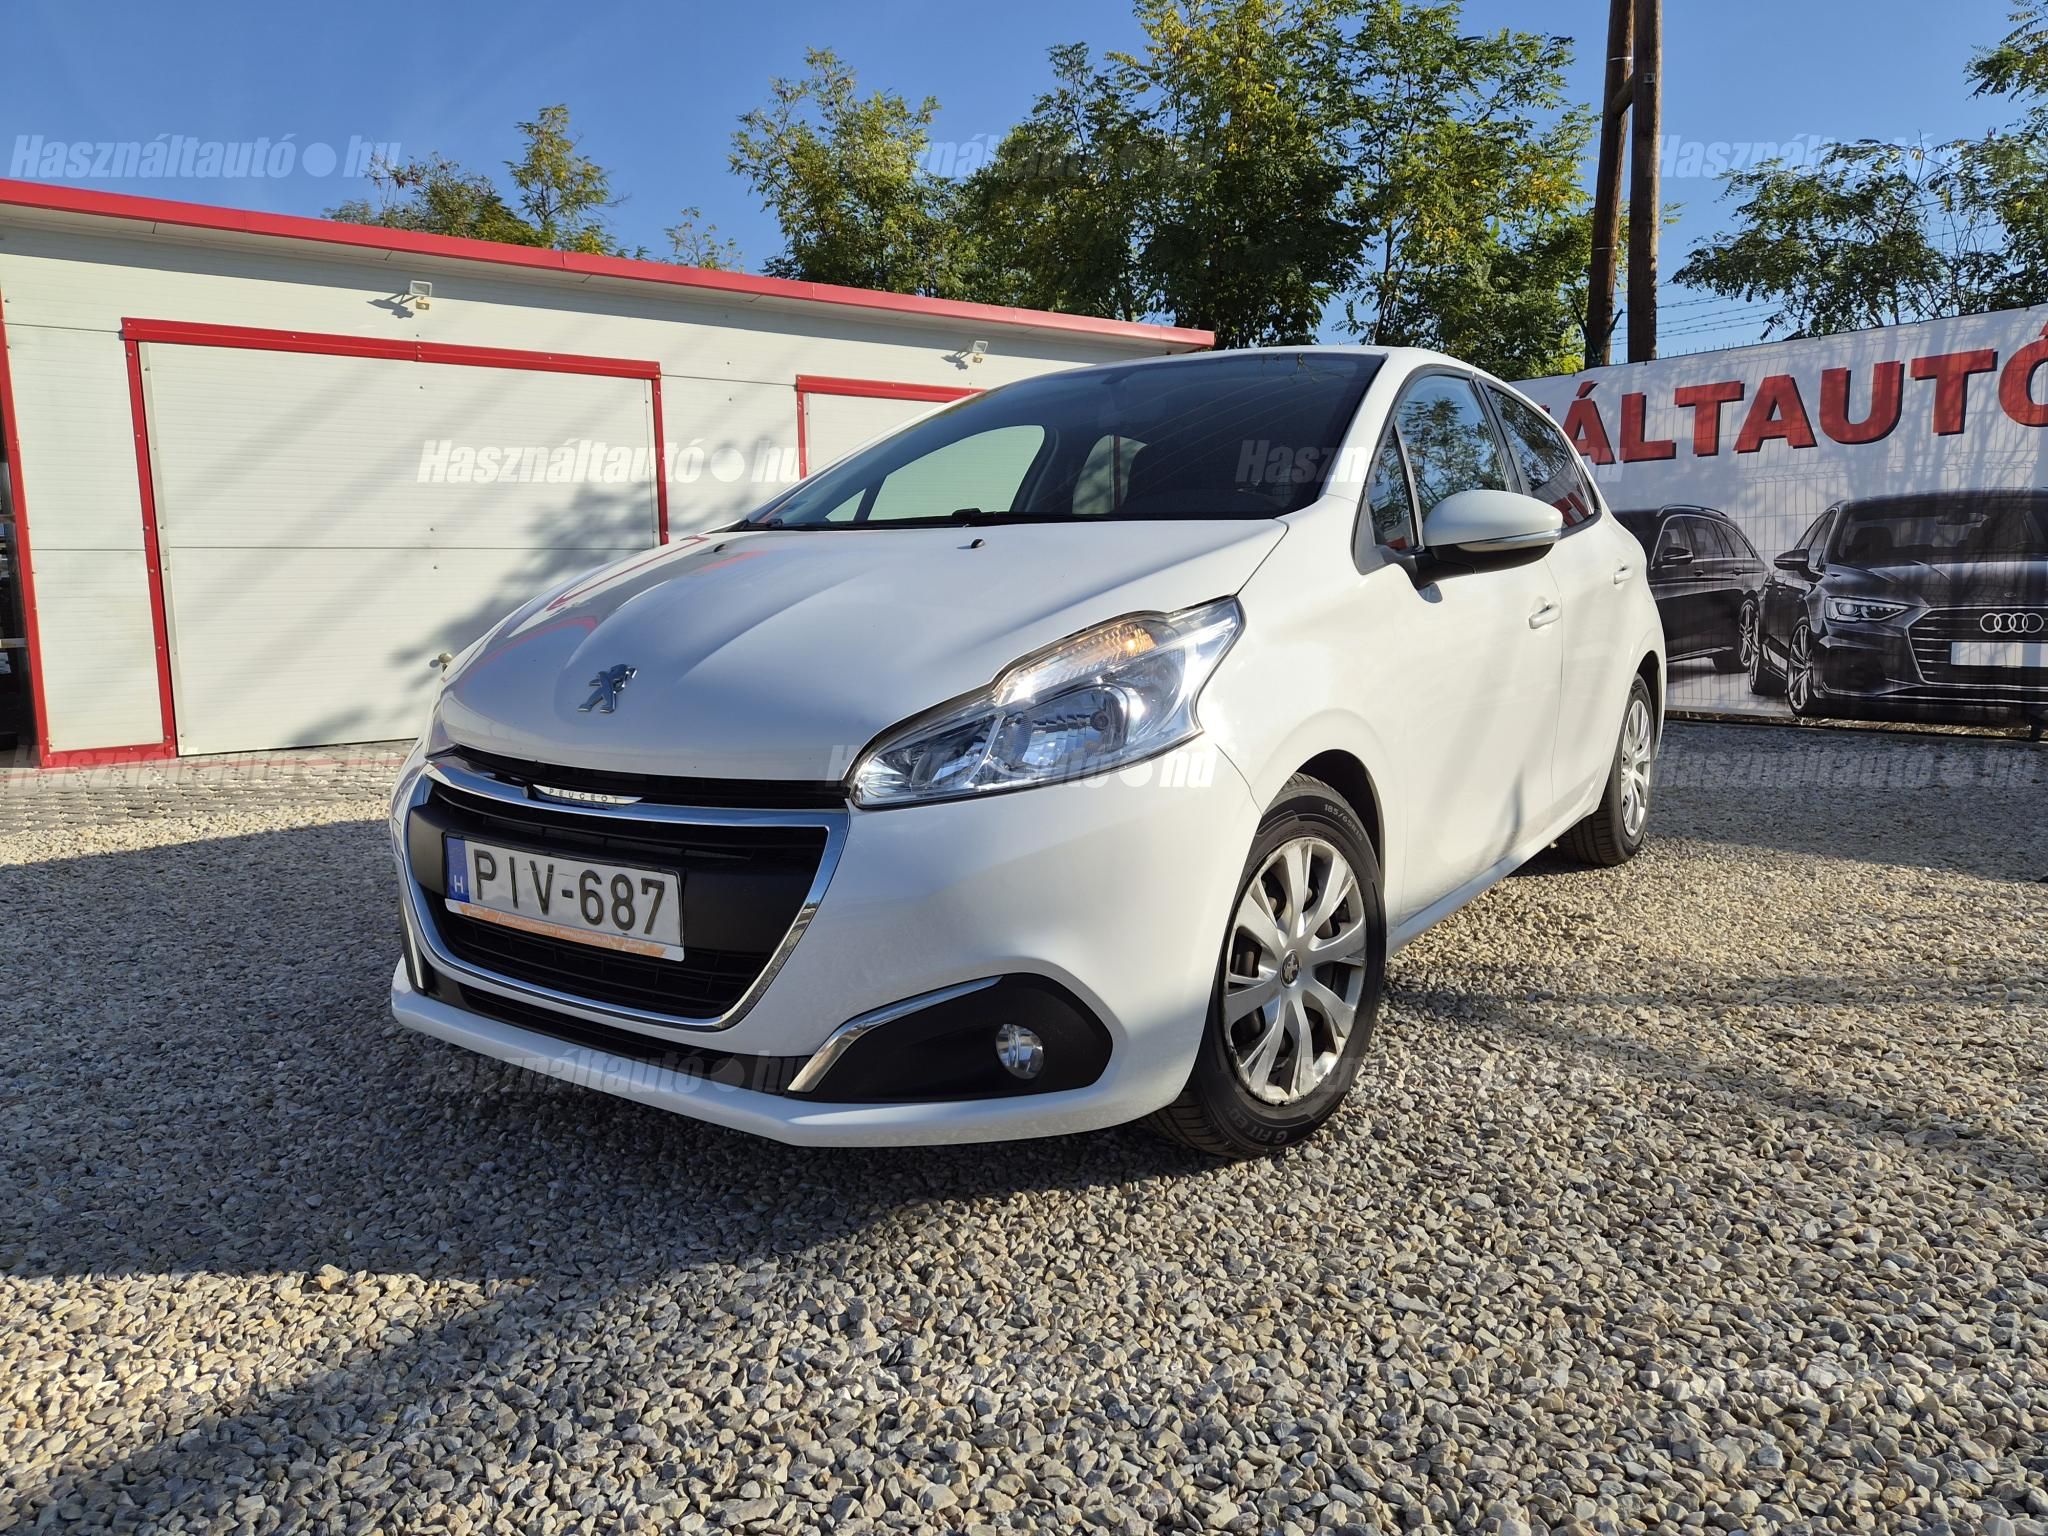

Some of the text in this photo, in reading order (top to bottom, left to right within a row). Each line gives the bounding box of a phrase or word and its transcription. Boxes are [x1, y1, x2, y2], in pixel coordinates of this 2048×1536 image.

[1541, 320, 2048, 465] ÁLTAUTÓ
[549, 788, 617, 804] PEUGEOT
[453, 879, 465, 894] H
[473, 848, 665, 935] PIV-687
